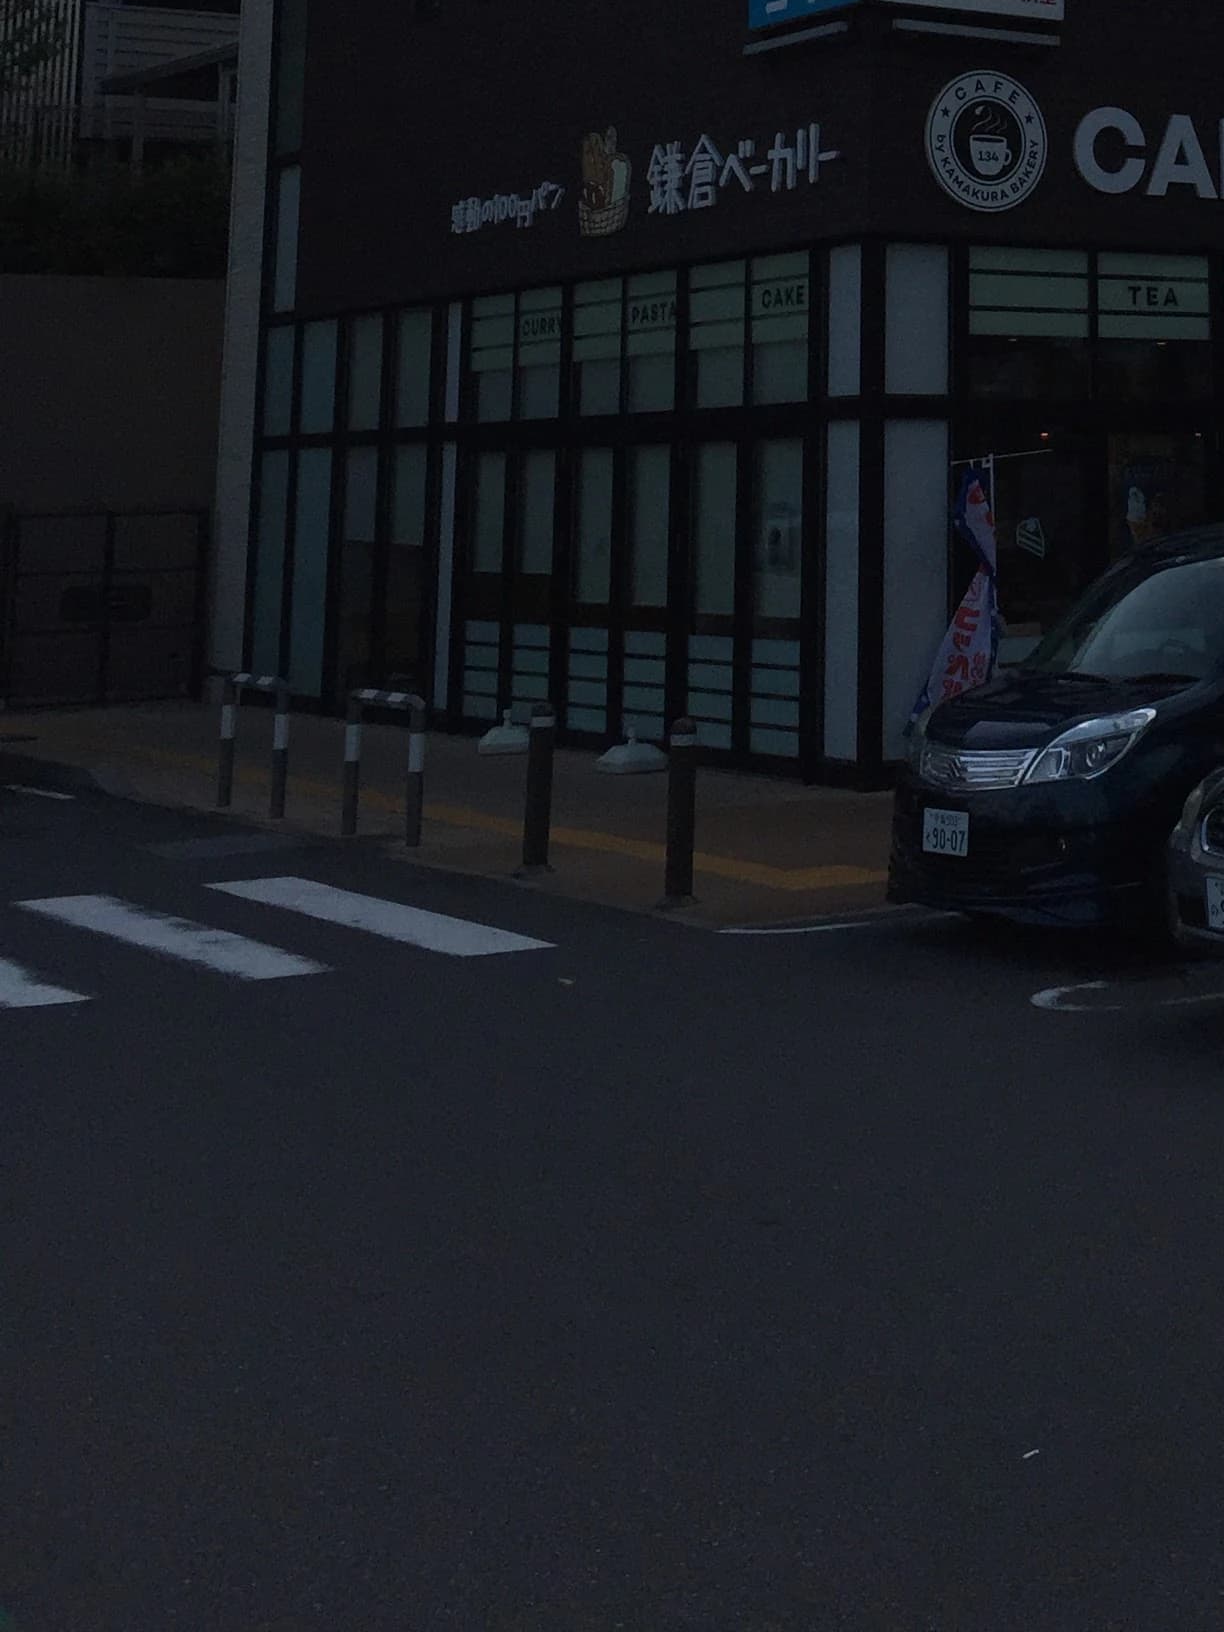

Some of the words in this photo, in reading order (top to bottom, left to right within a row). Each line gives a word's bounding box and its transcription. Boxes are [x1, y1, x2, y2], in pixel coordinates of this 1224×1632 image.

[954, 79, 1020, 105] CAFE
[646, 122, 841, 215] 鎌倉ベーカリー
[977, 150, 999, 162] 134
[941, 156, 1010, 202] KAMAKURA
[1009, 140, 1039, 194] BAKERY
[762, 285, 804, 309] CAKE
[1127, 285, 1179, 307] TEA
